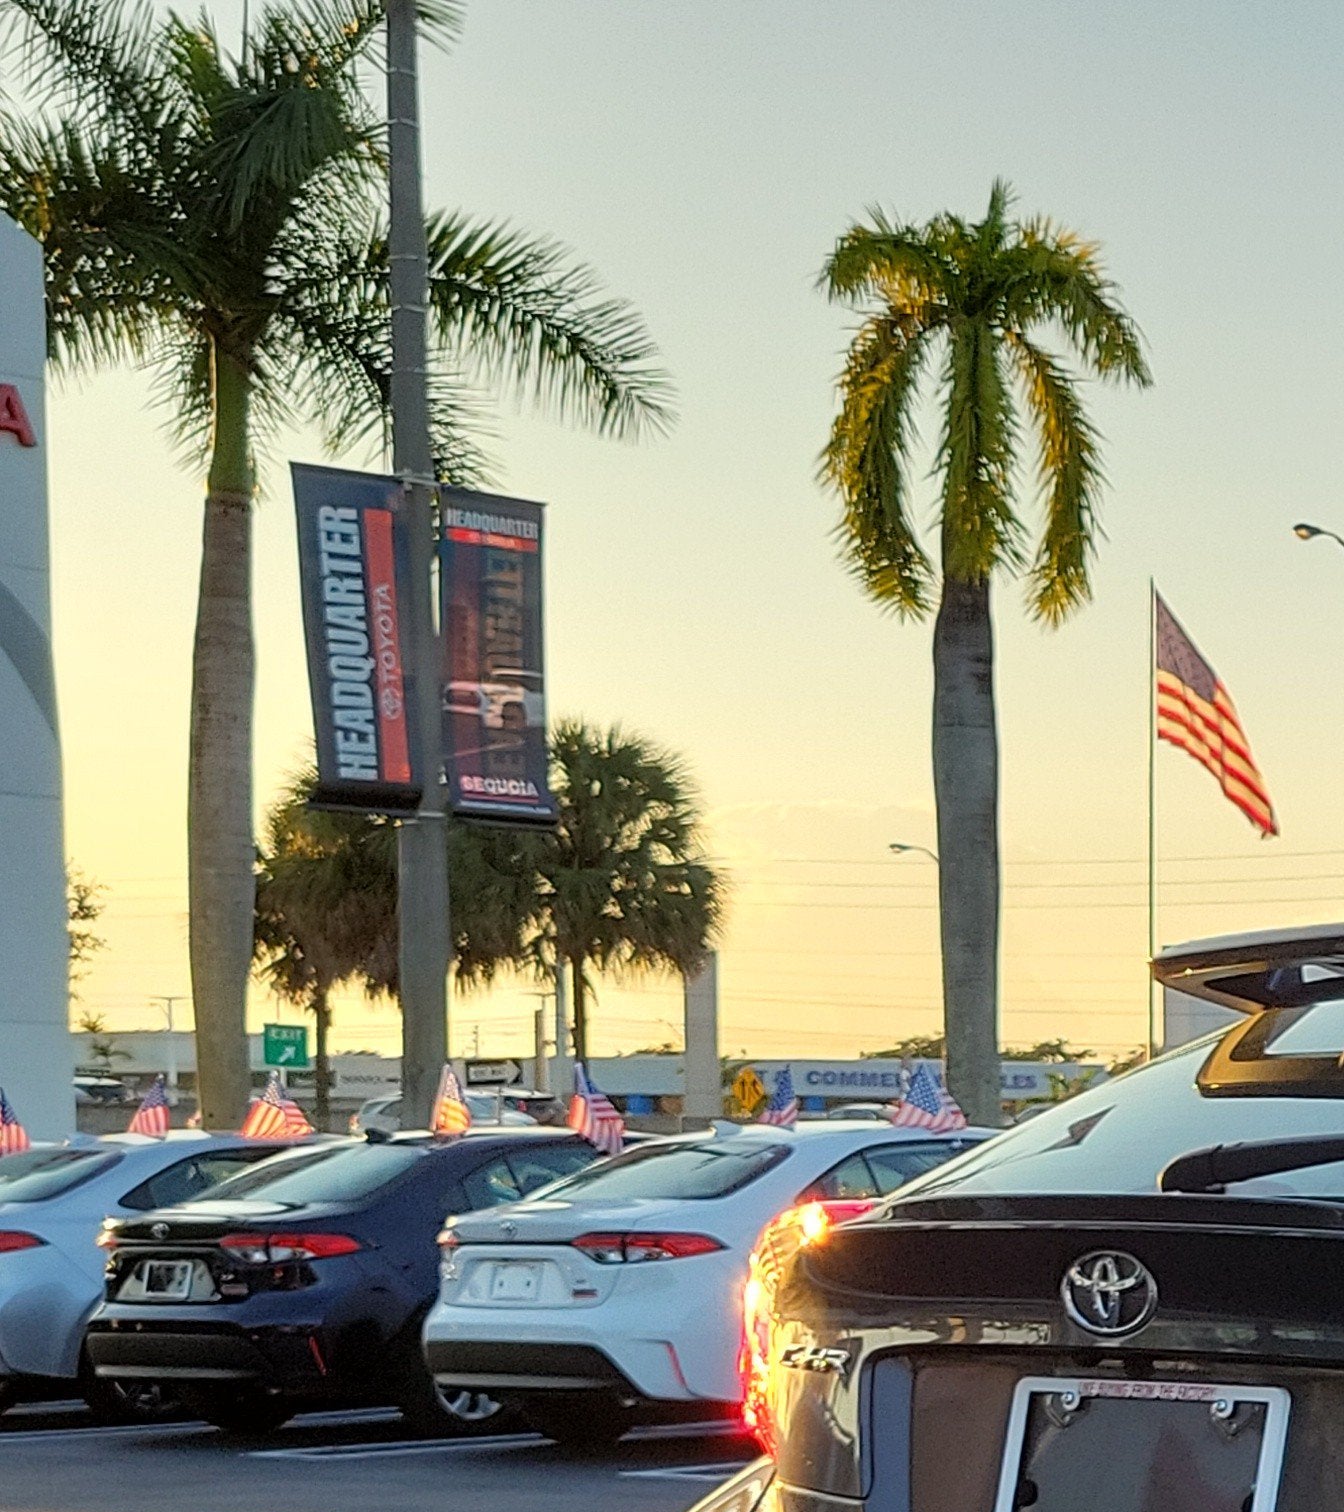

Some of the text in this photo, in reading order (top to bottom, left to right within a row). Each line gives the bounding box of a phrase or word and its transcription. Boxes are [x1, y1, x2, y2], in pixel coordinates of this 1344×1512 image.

[446, 508, 539, 540] HEADQUARTER
[318, 504, 379, 782] HEADQUARTER
[373, 583, 399, 684] TOYOTA
[460, 775, 539, 798] SEQUOIA
[268, 1027, 303, 1041] EXIT
